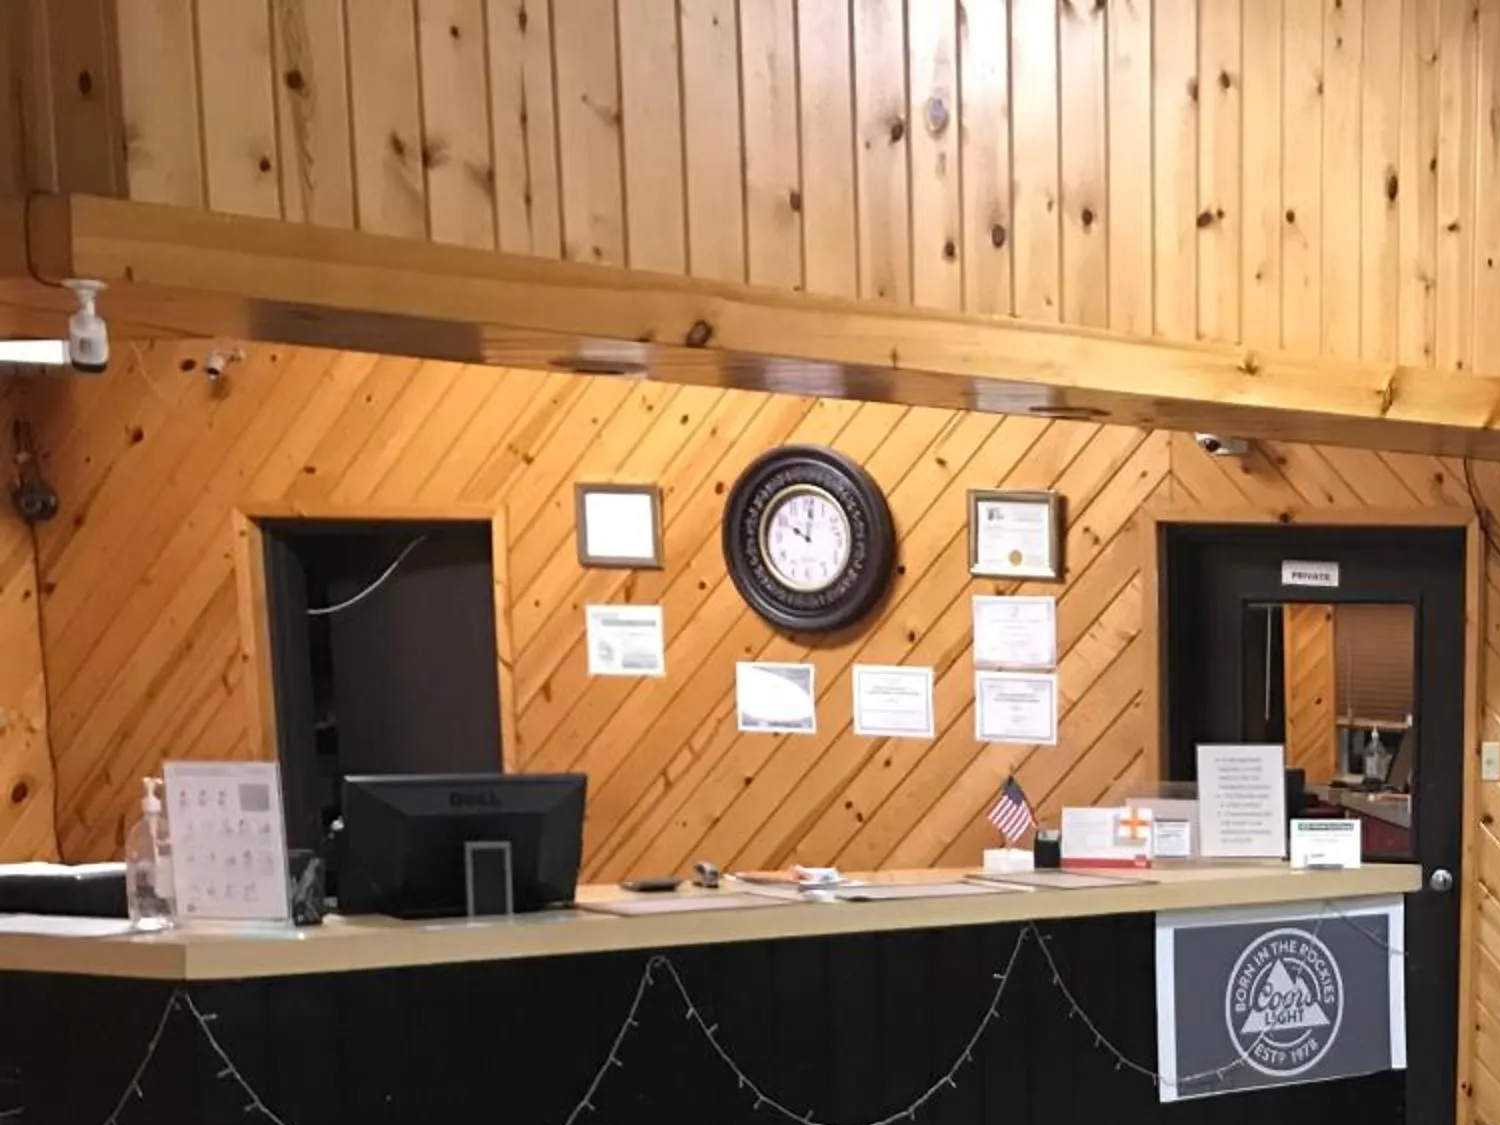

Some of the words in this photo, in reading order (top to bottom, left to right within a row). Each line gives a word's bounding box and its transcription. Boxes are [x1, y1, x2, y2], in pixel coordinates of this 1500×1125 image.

[1290, 570, 1331, 581] PRIVATE
[449, 791, 503, 808] DELL
[1234, 962, 1256, 1013] BORN
[1253, 946, 1269, 966] IN
[1270, 939, 1298, 957] THE
[1254, 982, 1314, 1012] Coors
[1264, 1008, 1305, 1026] LIGHT
